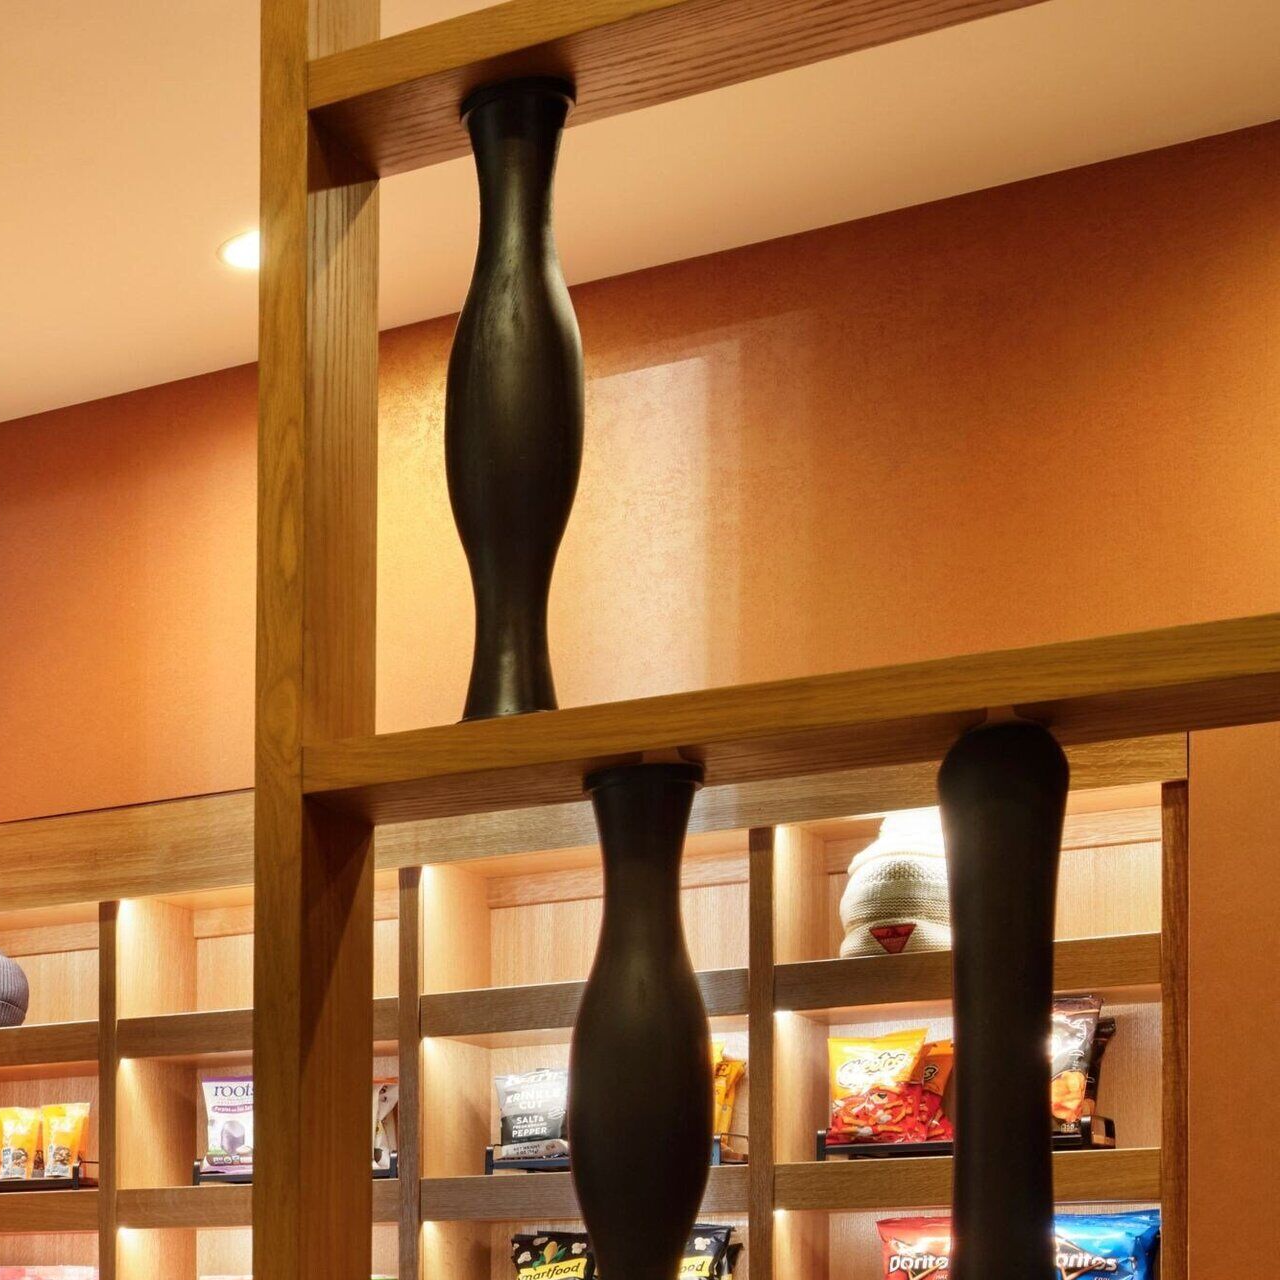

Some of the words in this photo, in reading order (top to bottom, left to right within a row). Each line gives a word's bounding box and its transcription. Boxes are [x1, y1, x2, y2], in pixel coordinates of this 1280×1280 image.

[214, 1083, 253, 1097] root
[516, 1115, 537, 1125] SALT
[512, 1127, 547, 1138] PEPPER
